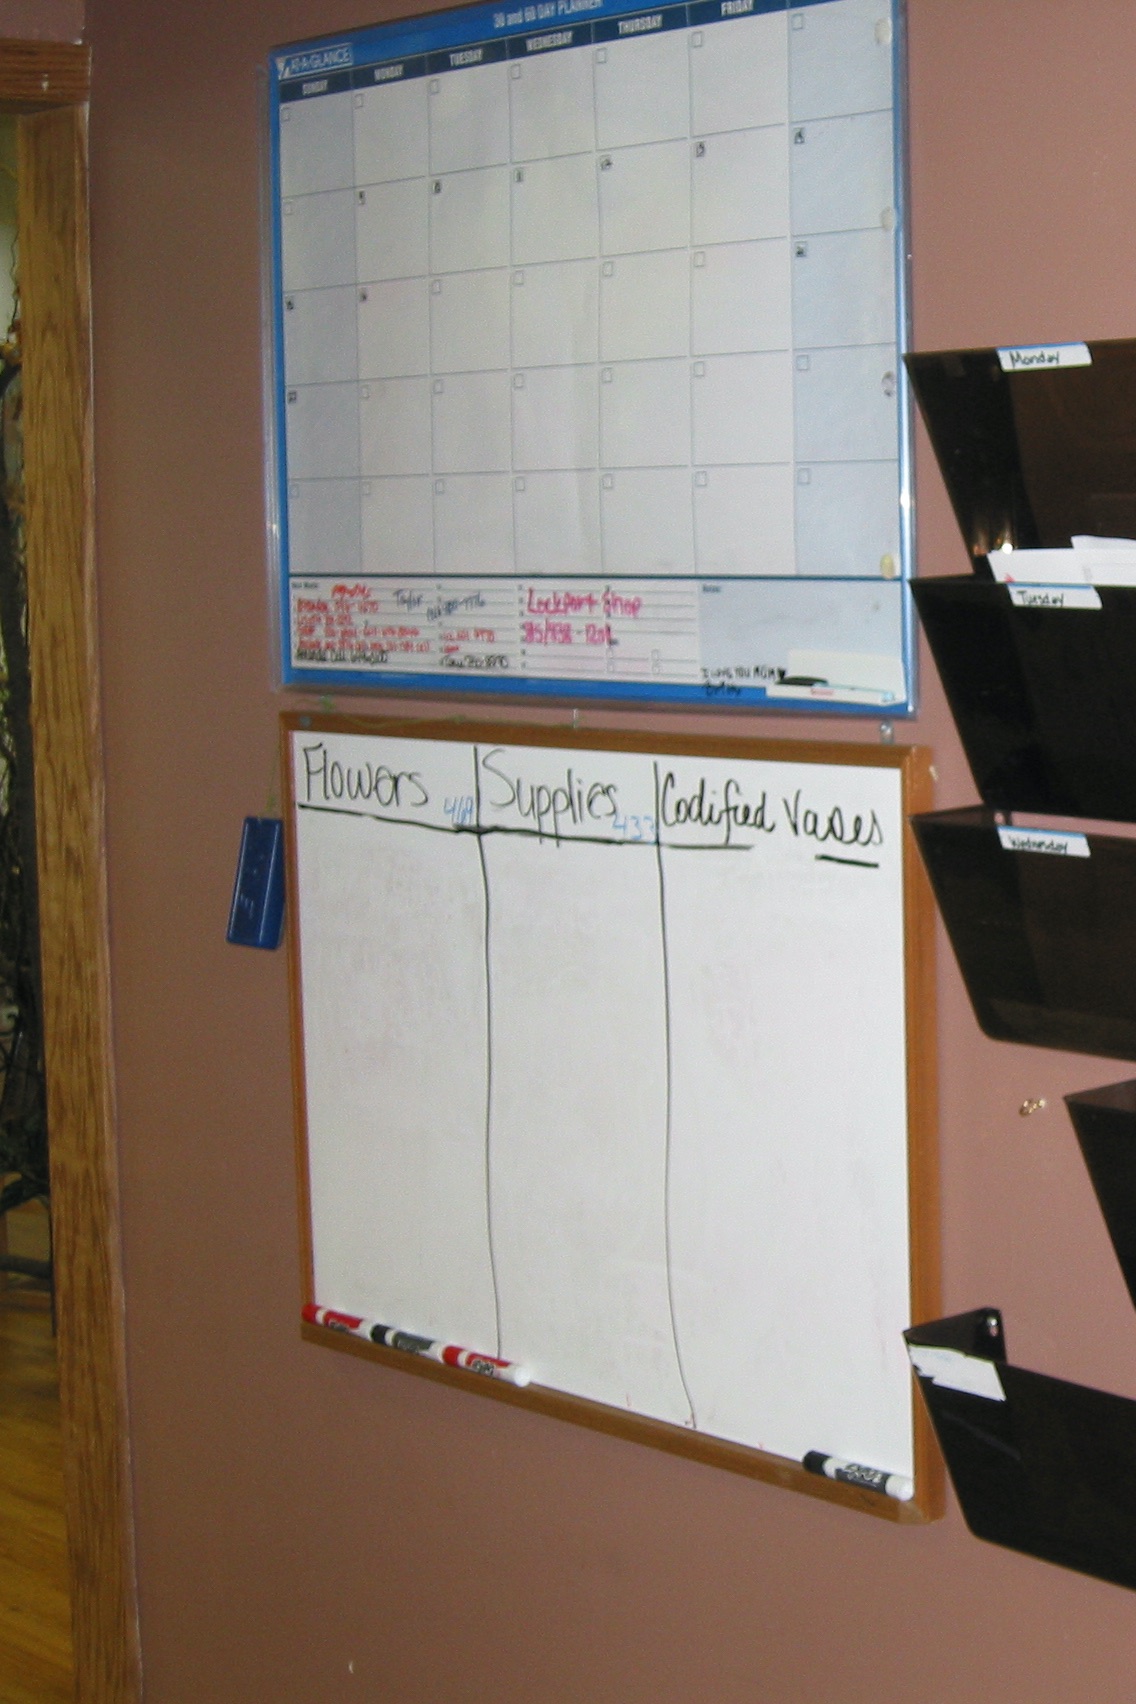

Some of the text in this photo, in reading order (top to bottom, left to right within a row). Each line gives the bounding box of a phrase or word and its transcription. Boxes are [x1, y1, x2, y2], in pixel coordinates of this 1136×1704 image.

[506, 8, 523, 25] and
[537, 2, 556, 19] DAY
[721, 0, 754, 16] FRIDAY
[618, 14, 663, 34] THURSDAY
[526, 31, 573, 51] WEDNESDAY
[450, 49, 484, 67] TUESDAY
[1009, 351, 1060, 369] Monday
[1016, 590, 1064, 607] Tuesday
[303, 743, 428, 807] Flowers
[482, 748, 617, 848] Supplies
[782, 789, 884, 846] Vases
